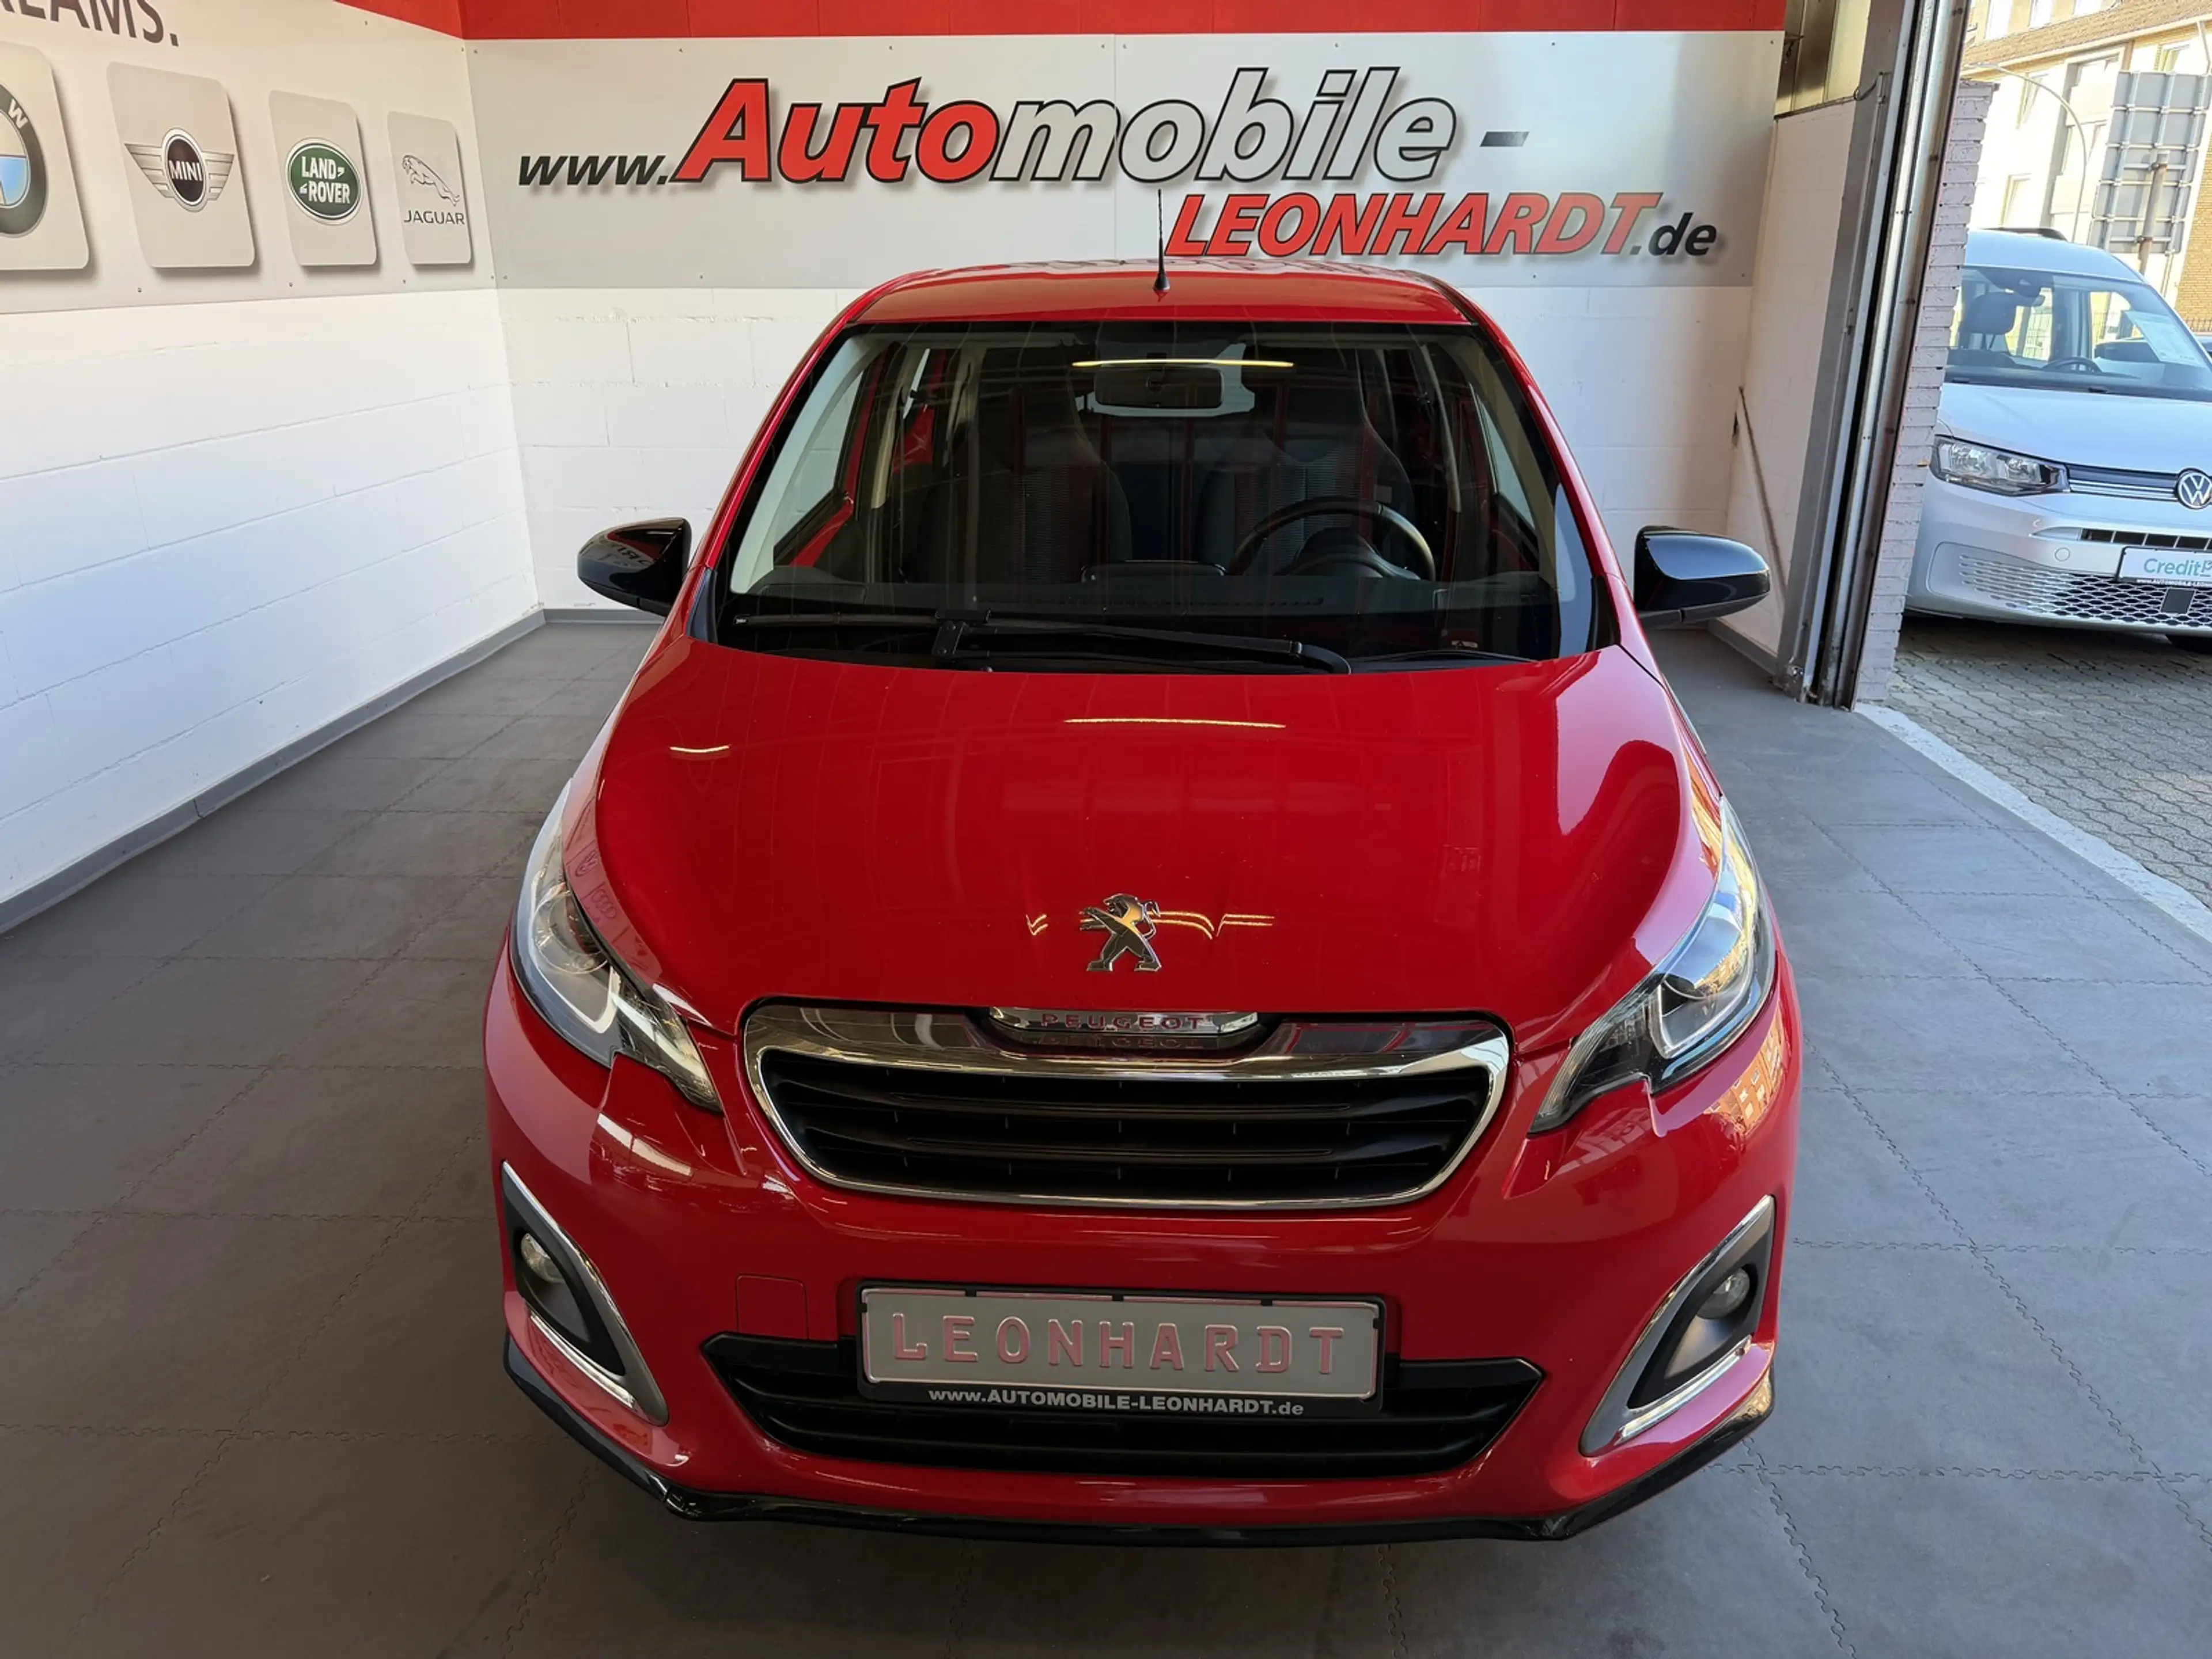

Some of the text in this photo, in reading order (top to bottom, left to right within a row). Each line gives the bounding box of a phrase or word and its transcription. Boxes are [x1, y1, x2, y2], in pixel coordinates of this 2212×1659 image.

[168, 160, 203, 182] MINI
[301, 156, 338, 180] LAND
[308, 180, 351, 204] ROVER
[404, 210, 465, 225] JAGUAR
[1164, 192, 1717, 257] LEONHARDT.de
[1041, 1013, 1206, 1031] PEUGEOT
[892, 1312, 1344, 1375] LEONHARDT
[928, 1389, 1304, 1415] www.AUTOMOBILE-LEONHARDT.de
